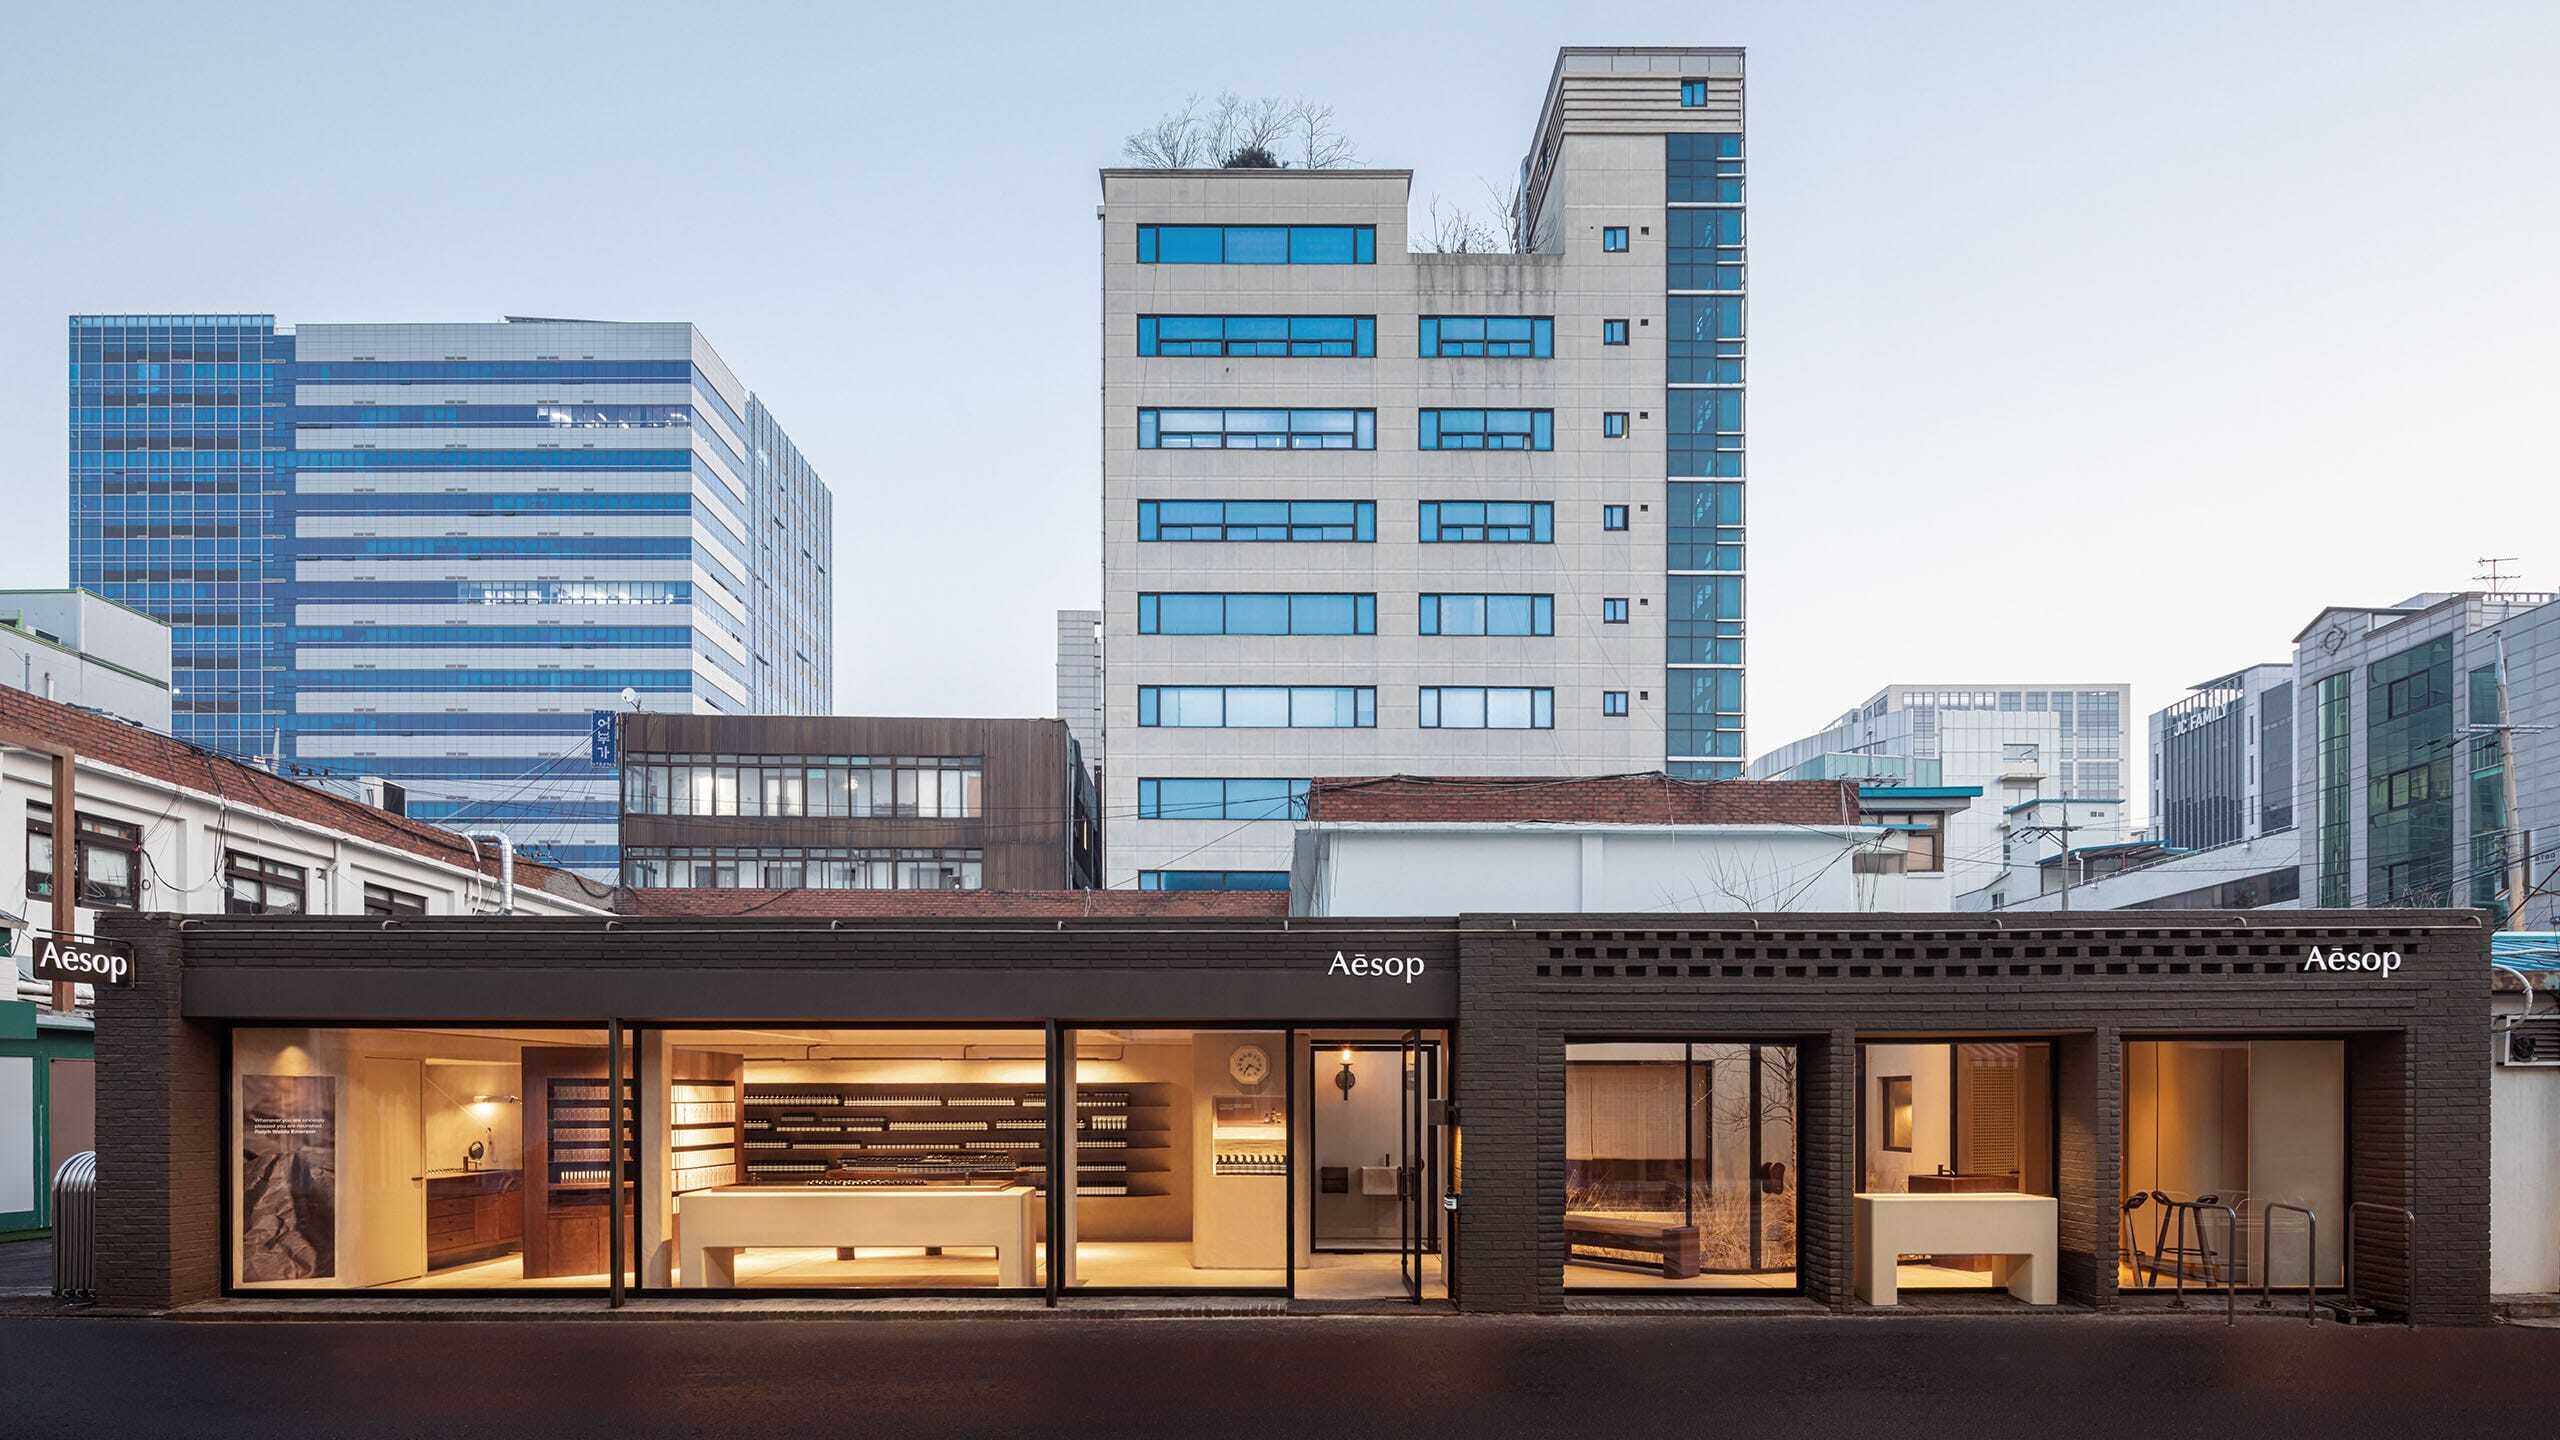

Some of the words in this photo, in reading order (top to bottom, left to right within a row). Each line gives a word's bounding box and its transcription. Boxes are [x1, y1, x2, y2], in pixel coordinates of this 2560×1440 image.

[2174, 719, 2188, 737] JC
[2190, 702, 2228, 731] FAMILY
[597, 716, 611, 760] 어부가
[39, 941, 128, 984] Aēsop
[1327, 950, 1425, 984] Aēsop
[2303, 945, 2401, 979] Aēsop
